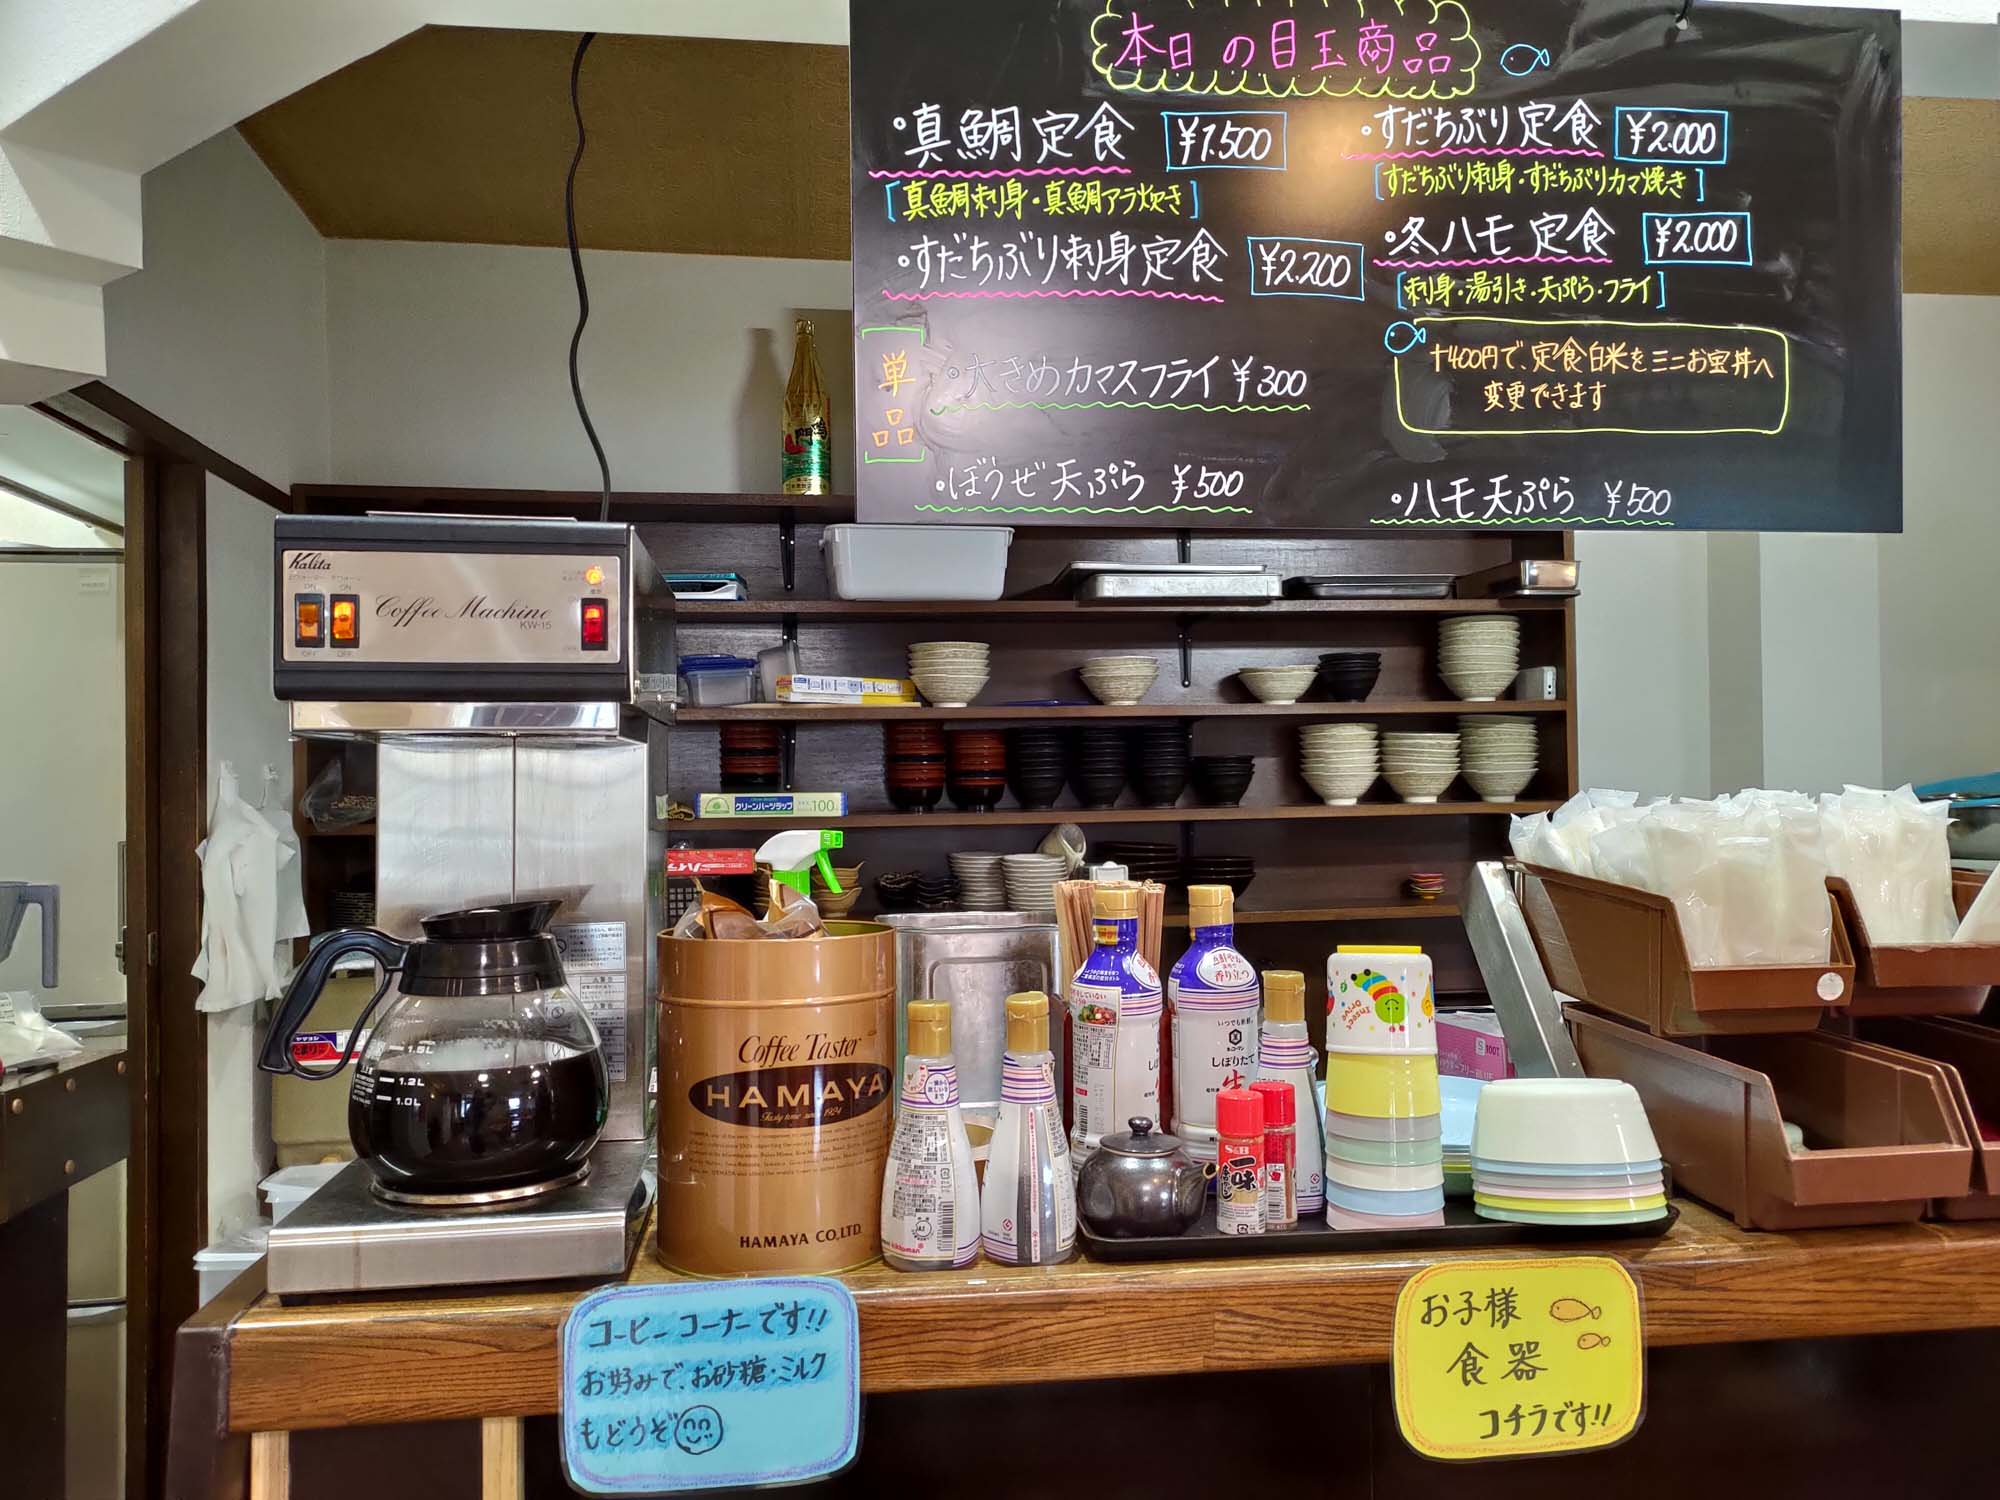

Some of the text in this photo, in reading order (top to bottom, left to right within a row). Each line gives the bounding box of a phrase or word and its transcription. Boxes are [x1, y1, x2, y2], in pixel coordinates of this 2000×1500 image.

[1113, 12, 1452, 74] 本日の目玉商品
[1232, 356, 1307, 403] ¥300
[1483, 380, 1609, 412] 変更できます
[872, 350, 915, 446] 単品
[1171, 463, 1244, 502] ¥500
[1605, 480, 1673, 518] ¥500
[288, 552, 332, 571] Kalita
[375, 594, 553, 628] Coffee Machine
[519, 620, 553, 631] KW-15
[738, 1032, 862, 1067] Coffee Taster
[1211, 1053, 1256, 1069] しぼりたて
[399, 1077, 425, 1087] 1.2L
[706, 1073, 885, 1109] HAMAYA
[1222, 1069, 1246, 1091] 生
[395, 1096, 421, 1106] 1.0L
[740, 1232, 809, 1249] HAMAYA
[1420, 1286, 1522, 1329] お子様
[1446, 1341, 1549, 1387] 食器
[581, 1411, 679, 1451] もどうぞ
